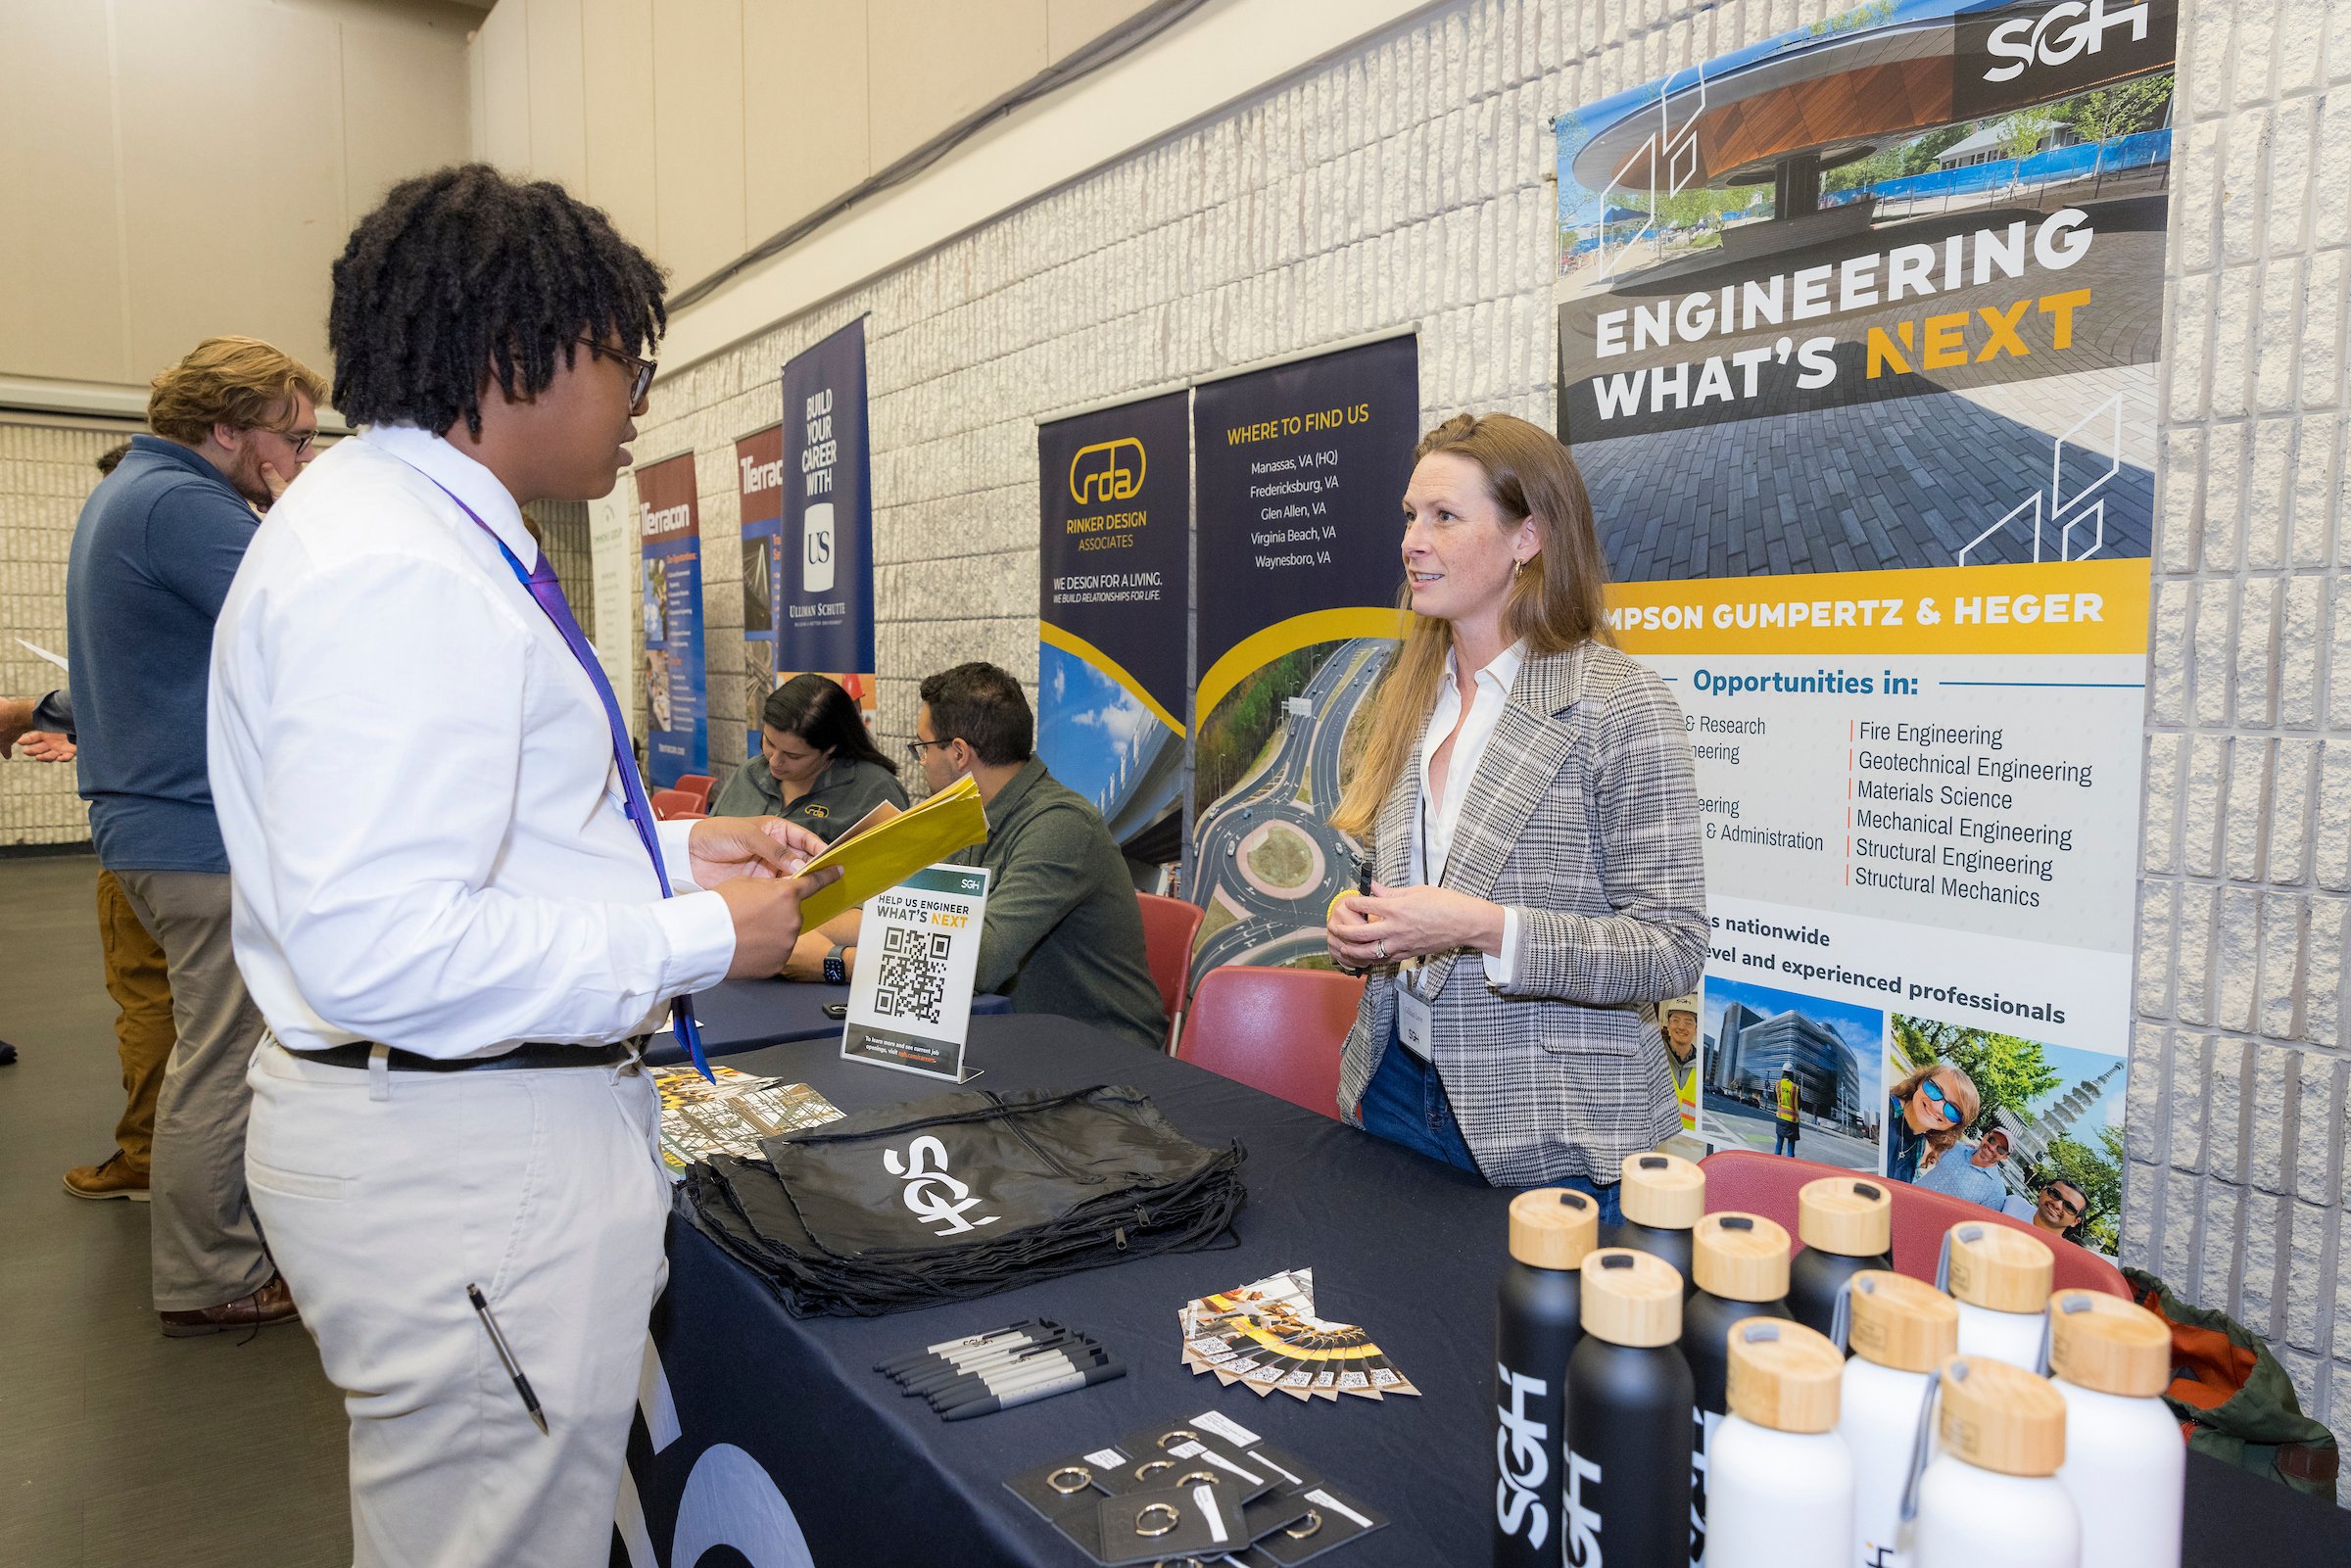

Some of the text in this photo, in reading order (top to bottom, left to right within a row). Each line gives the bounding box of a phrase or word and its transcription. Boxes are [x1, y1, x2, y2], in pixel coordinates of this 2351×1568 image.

[1982, 0, 2148, 82] SGH
[1596, 209, 2093, 357] ENGINEERING
[1592, 288, 2091, 420] WHAT'S NEXT
[806, 388, 832, 421] BUILD
[807, 415, 832, 443] YOUR
[1226, 404, 1369, 446] WHERE TO FIND US
[801, 440, 837, 475] CAREER
[1251, 450, 1338, 475] Manassas, VA (HQ)
[741, 454, 783, 495] Terrac
[806, 467, 833, 497] WITH
[1250, 476, 1338, 498] Fredericksburg, VA
[640, 500, 690, 537] Terracon
[1067, 510, 1147, 534] RINKER DESIGN
[1261, 502, 1326, 521] Glen Allen, VA
[808, 530, 830, 565] US
[1079, 534, 1133, 551] ASSOCIATES
[1250, 526, 1336, 546] Virginia Beach, VA
[1255, 551, 1331, 569] Waynesboro, VA
[1053, 571, 1163, 591] WE DESIGN FOR A LIVING.
[1053, 590, 1161, 603] WE BUILD RELATIONSHIPS FOR LIFE.
[1718, 598, 1903, 629] GUMPERTZ
[1916, 597, 1942, 626] &
[1954, 593, 2104, 624] HEGER
[1693, 669, 1918, 697] Opportunities in:
[1685, 715, 1765, 735] & Research
[1859, 722, 2003, 750] Fire Engineering
[1859, 751, 2092, 786] Geotechnical Engineering
[1858, 780, 2013, 810] Materials Science
[1706, 823, 1823, 851] & Administration
[1857, 808, 2073, 849] Mechanical Engineering
[1856, 837, 2053, 881] Structural Engineering
[961, 879, 980, 889] SGH
[1855, 866, 2039, 908] Structural Mechanics
[877, 905, 969, 928] WHAT'S NEXT
[878, 895, 970, 915] HELP US ENGINEER
[1726, 919, 1830, 946] nationwide
[1742, 954, 1775, 970] and
[1782, 961, 1901, 994] experienced
[1908, 979, 2066, 1025] professionals
[871, 1036, 883, 1045] learn
[884, 1135, 1001, 1237] SGH
[1496, 1361, 1549, 1550] SGH
